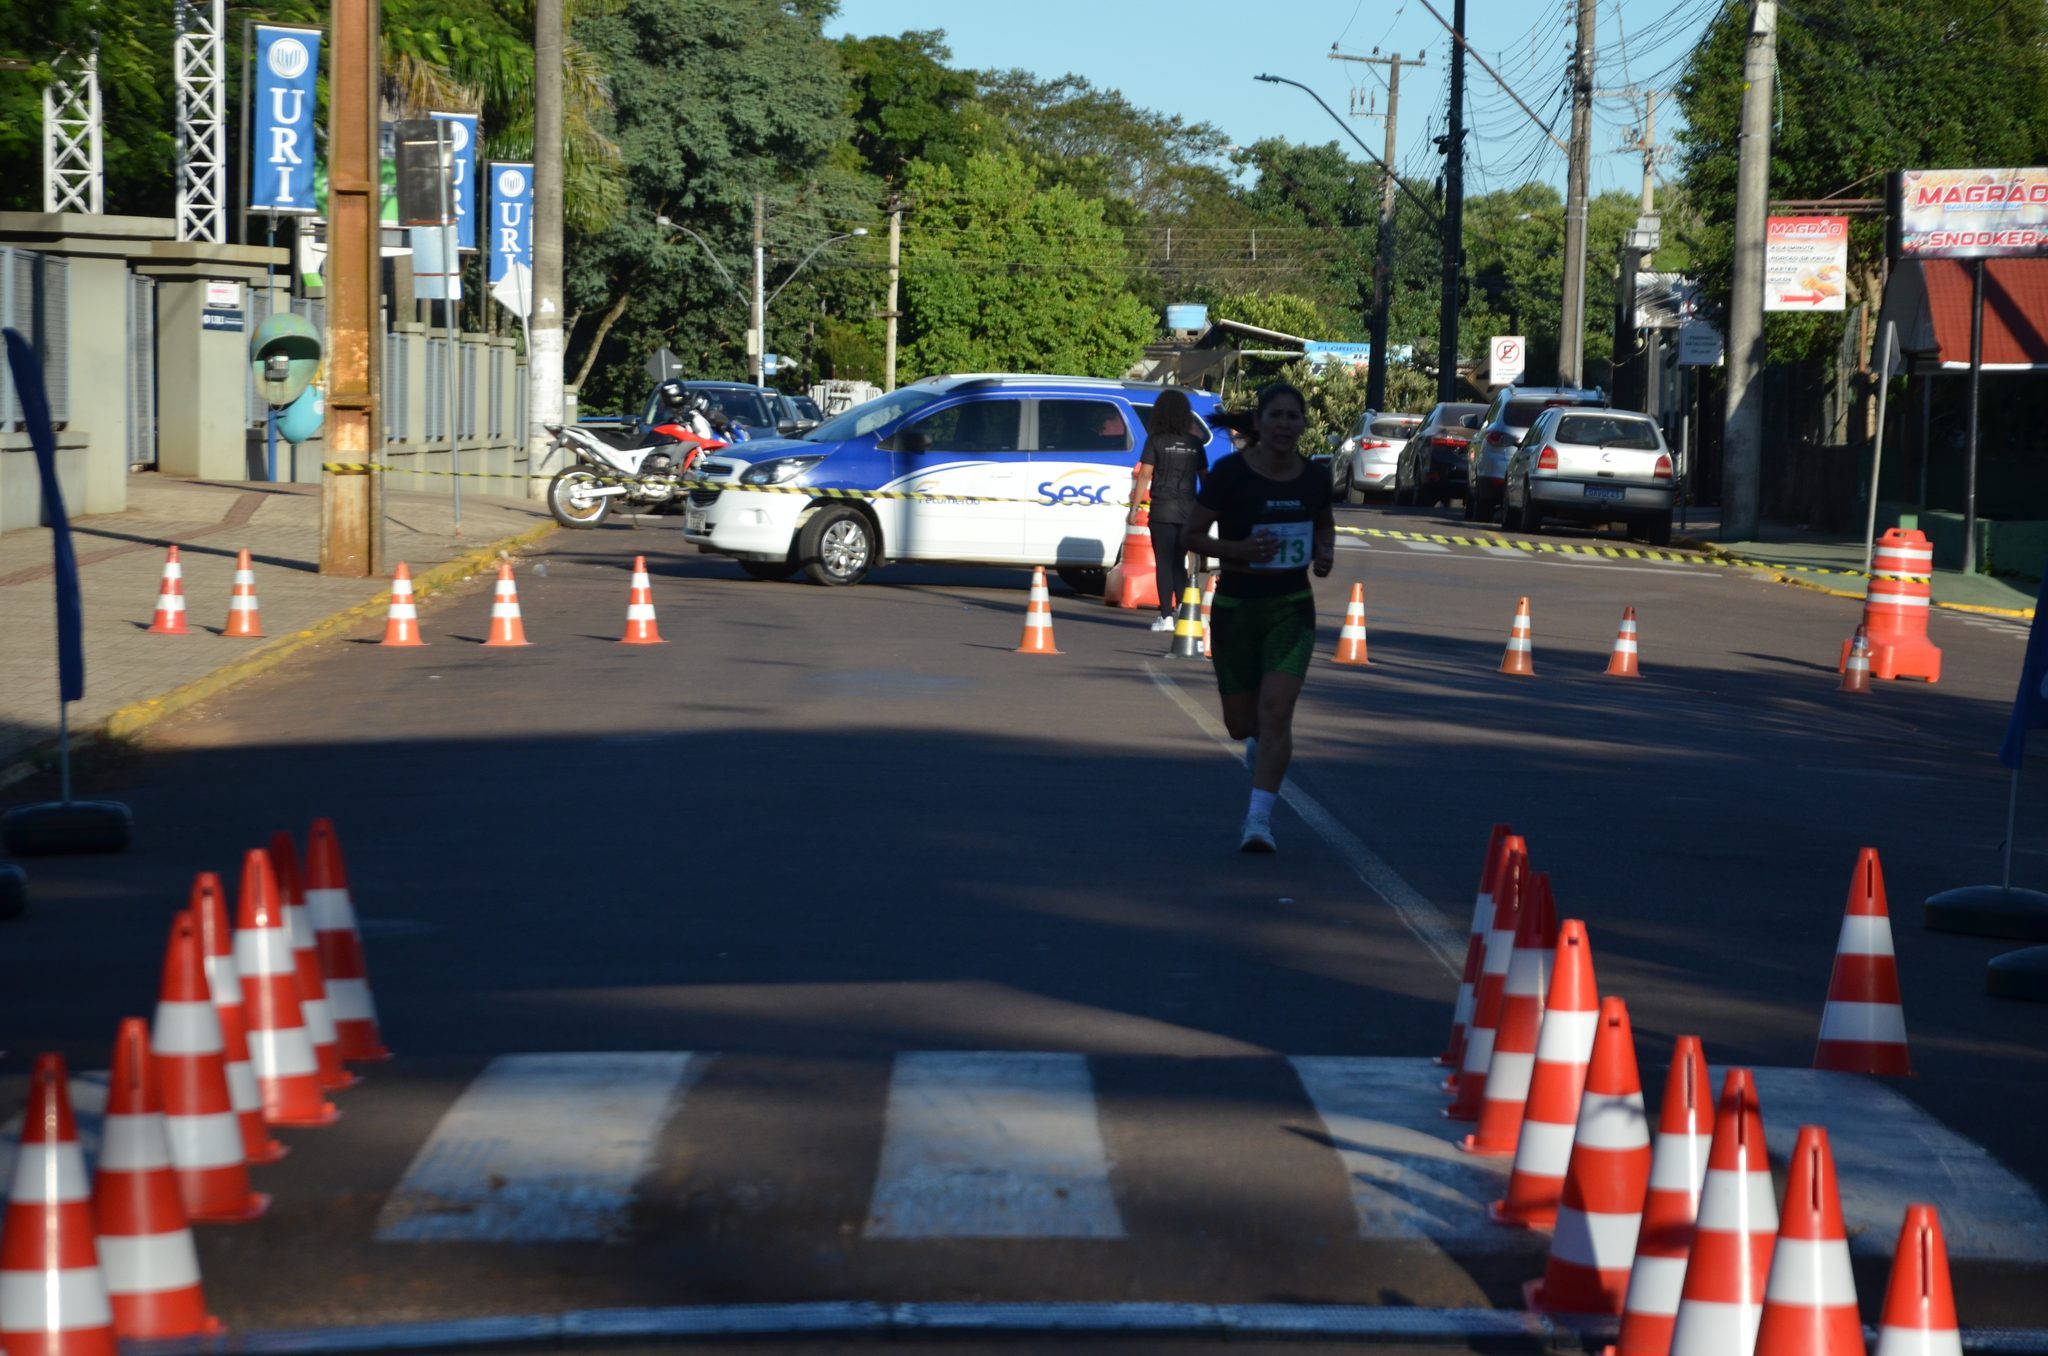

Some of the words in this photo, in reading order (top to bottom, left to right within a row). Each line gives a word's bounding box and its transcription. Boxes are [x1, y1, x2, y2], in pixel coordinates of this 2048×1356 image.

[268, 87, 306, 203] URI
[1917, 177, 2048, 205] MAGRÃO
[1770, 219, 1842, 235] MAGRÃO
[1930, 231, 2036, 247] SNOOKER
[1038, 481, 1111, 507] Sesc
